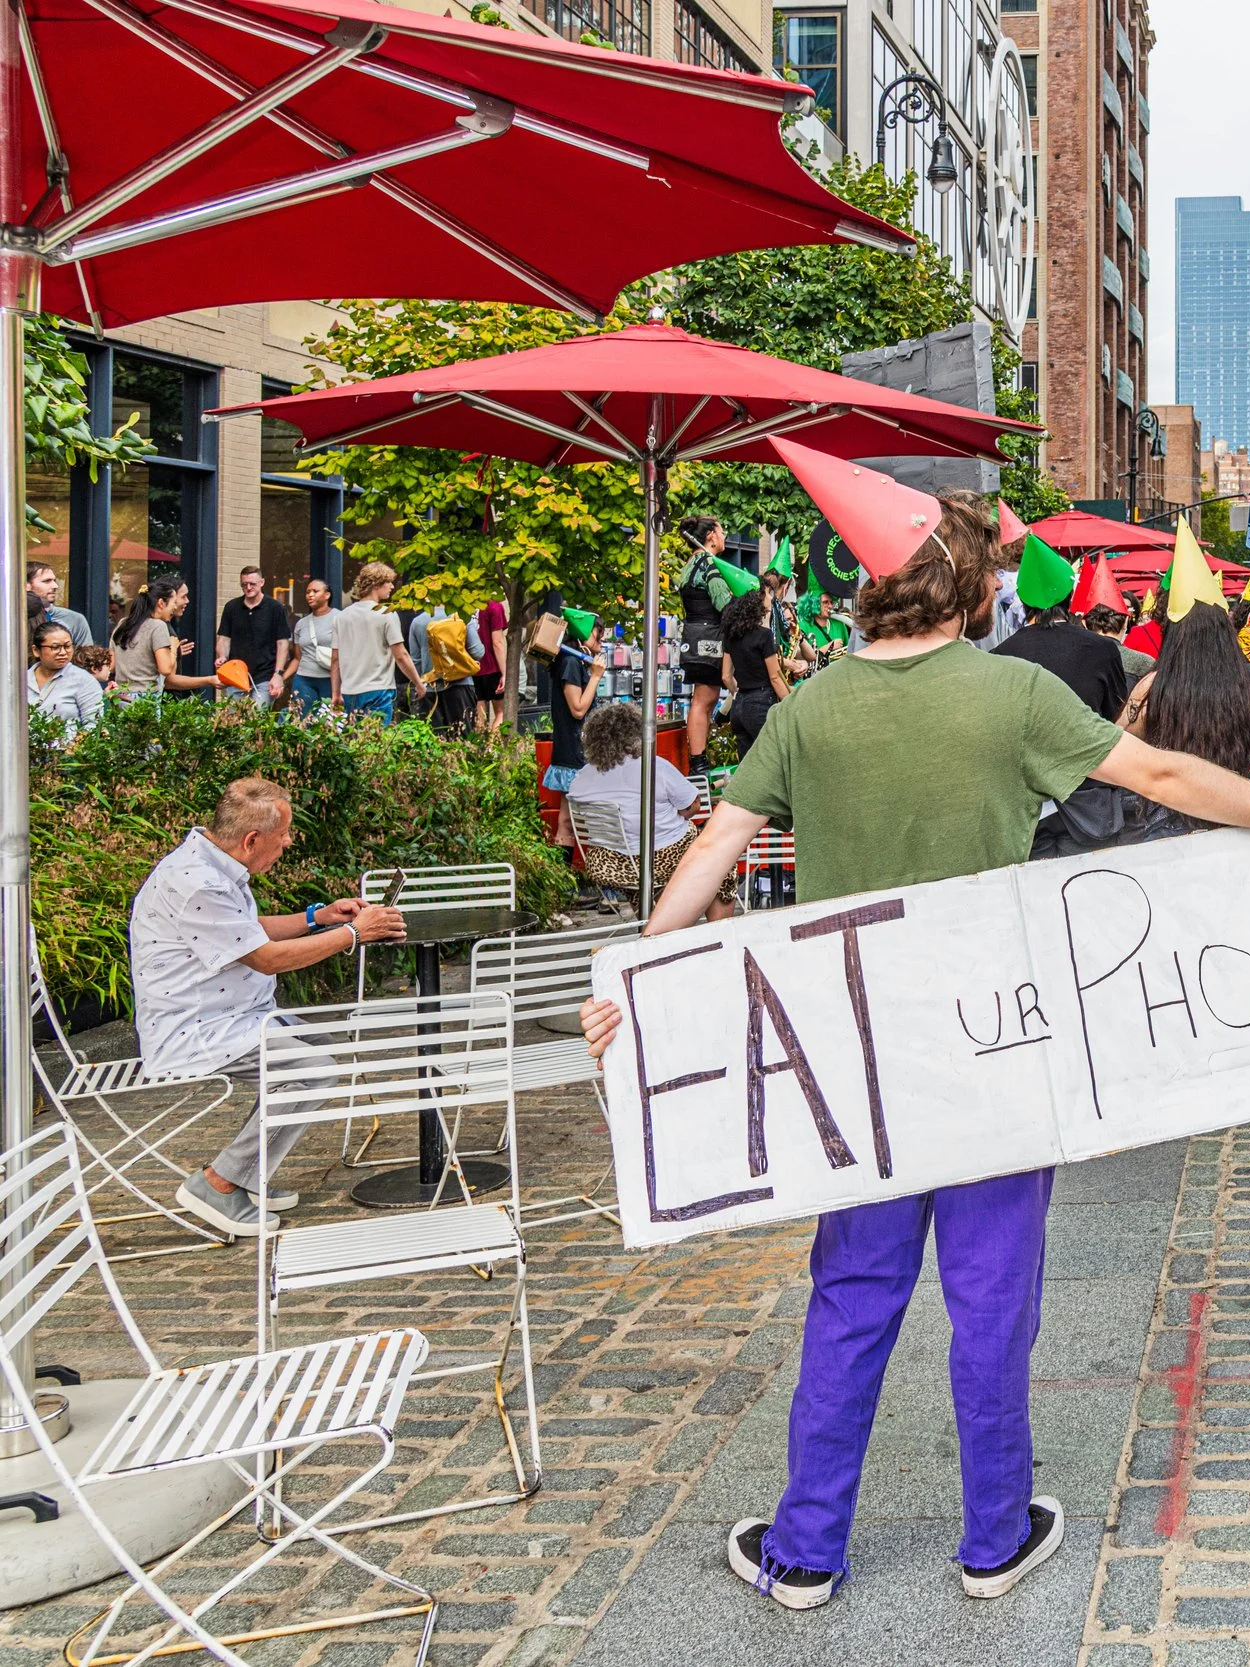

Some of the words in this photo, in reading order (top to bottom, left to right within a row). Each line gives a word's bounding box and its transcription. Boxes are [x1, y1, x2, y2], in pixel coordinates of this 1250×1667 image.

[826, 535, 842, 556] MEC
[826, 557, 860, 581] ORCHEST
[621, 898, 905, 1223] EAT
